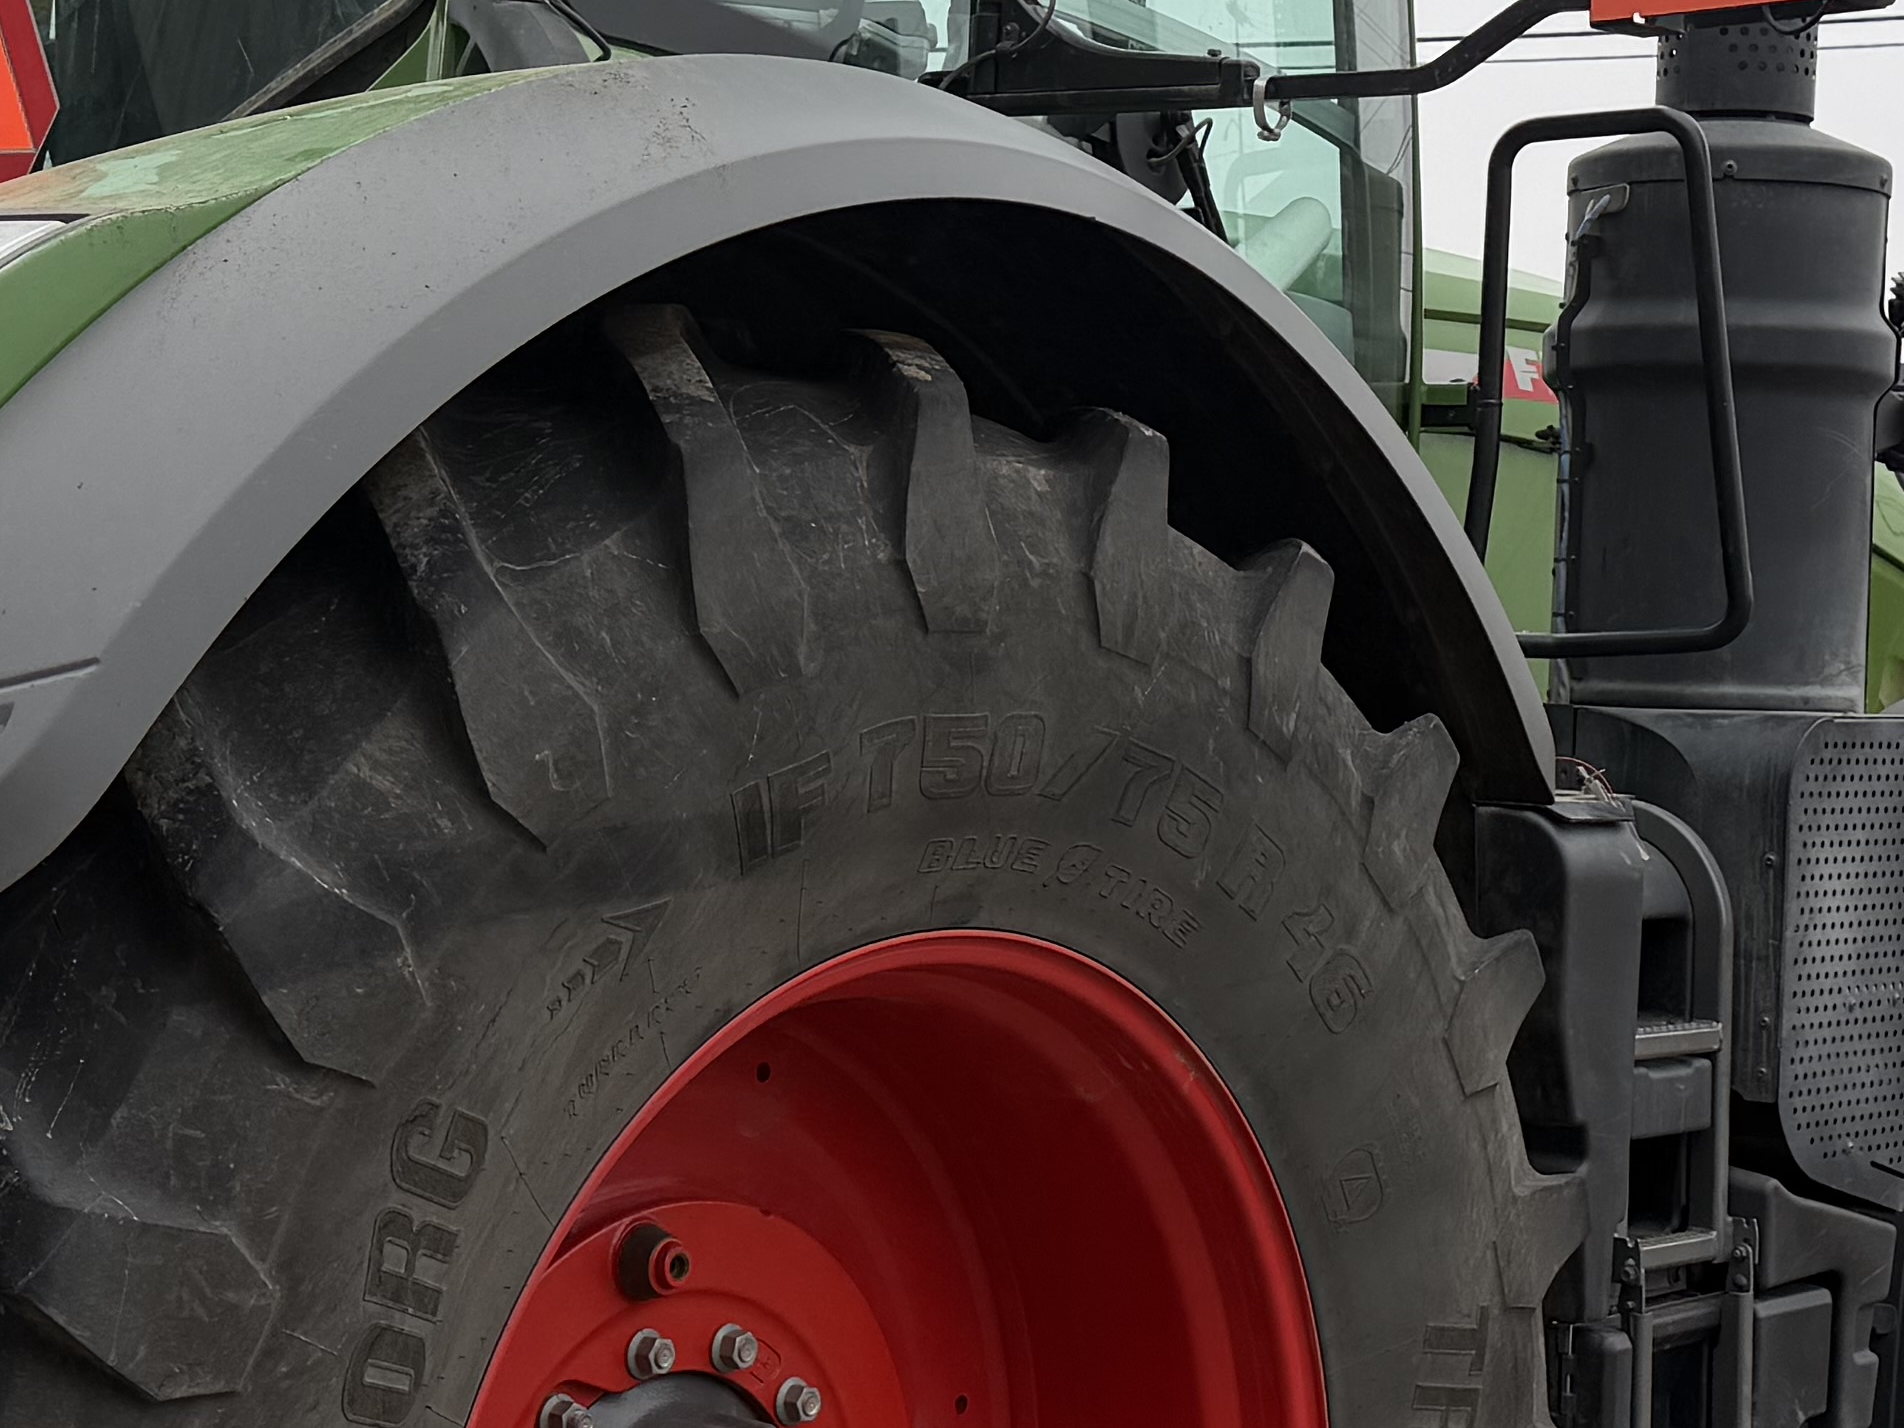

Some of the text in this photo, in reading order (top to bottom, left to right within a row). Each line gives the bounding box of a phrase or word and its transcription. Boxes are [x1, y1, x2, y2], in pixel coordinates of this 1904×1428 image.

[731, 750, 832, 877] IF
[917, 834, 1202, 950] BLUE TIRE
